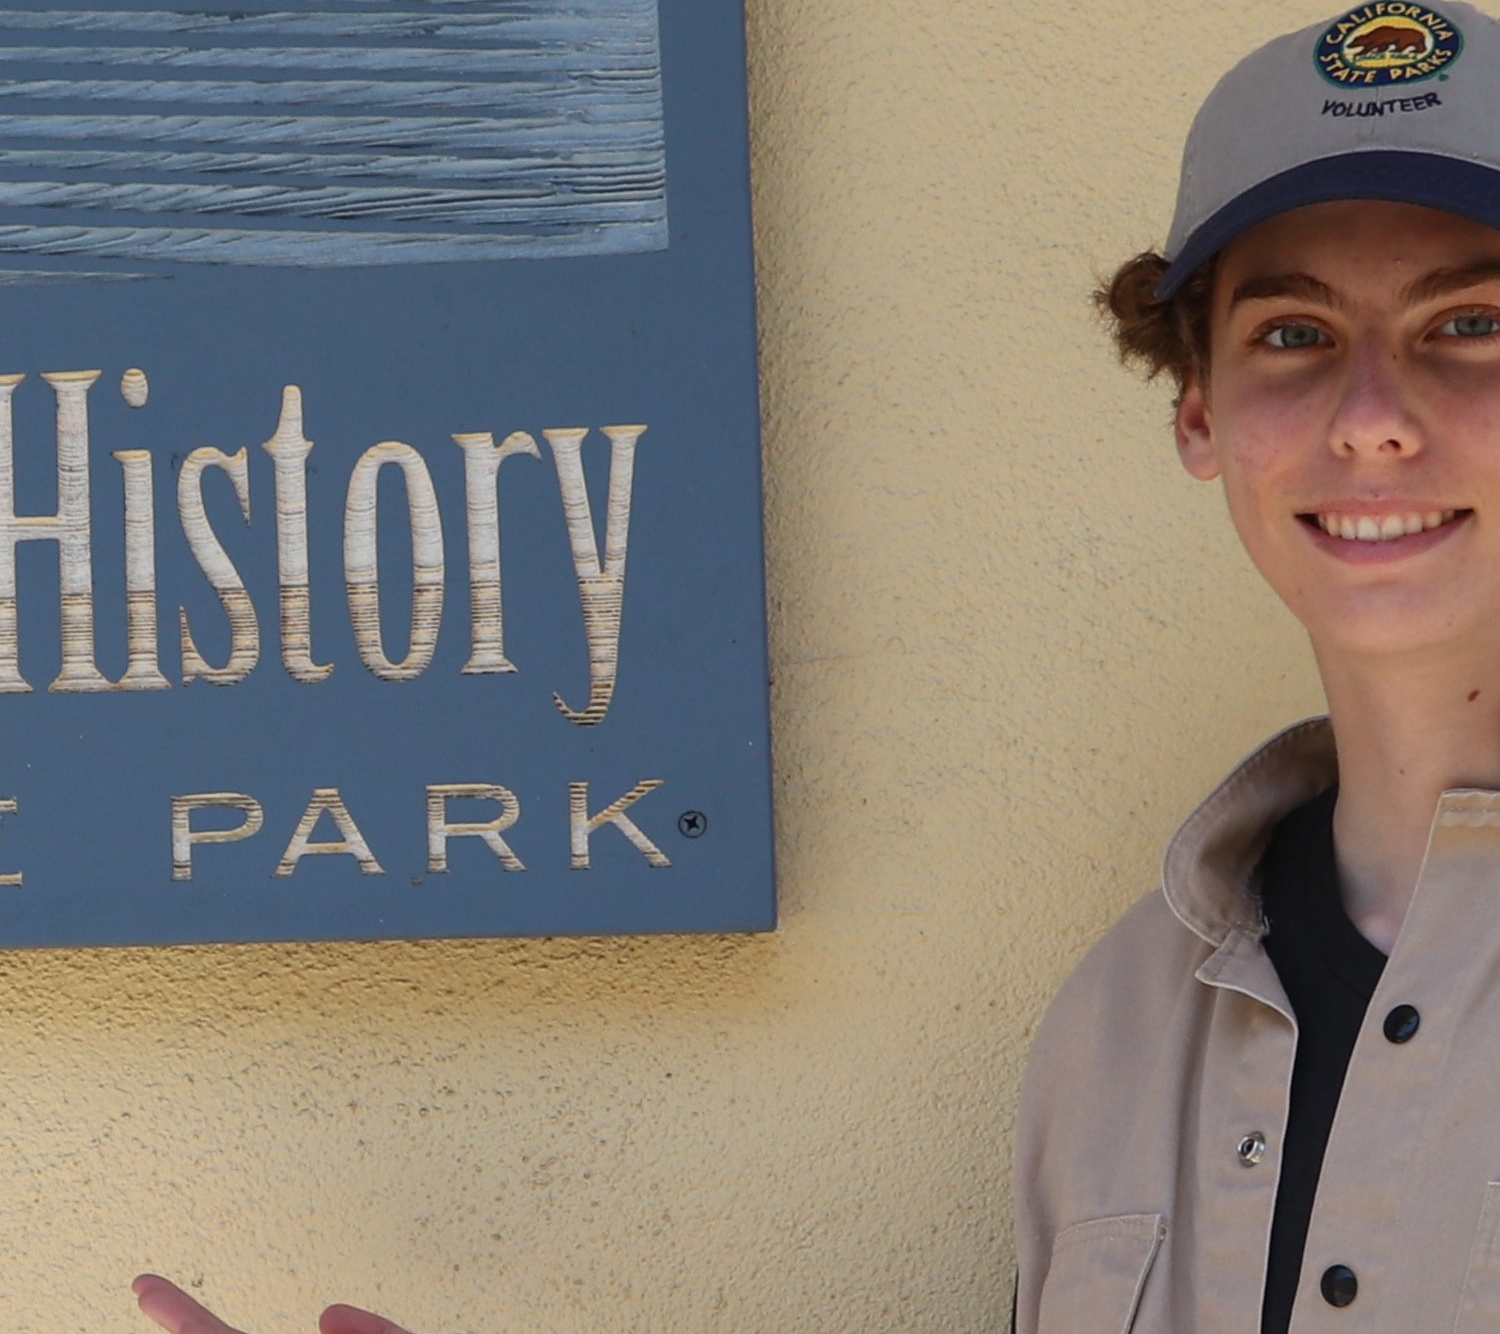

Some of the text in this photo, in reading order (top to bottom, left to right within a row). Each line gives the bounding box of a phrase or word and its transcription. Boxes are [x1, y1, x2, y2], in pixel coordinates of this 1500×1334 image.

[1326, 2, 1453, 44] CALIFORNIA
[1320, 48, 1453, 84] STATE PARKS
[1320, 91, 1443, 118] VOLUNTEER
[170, 779, 674, 881] PARK
